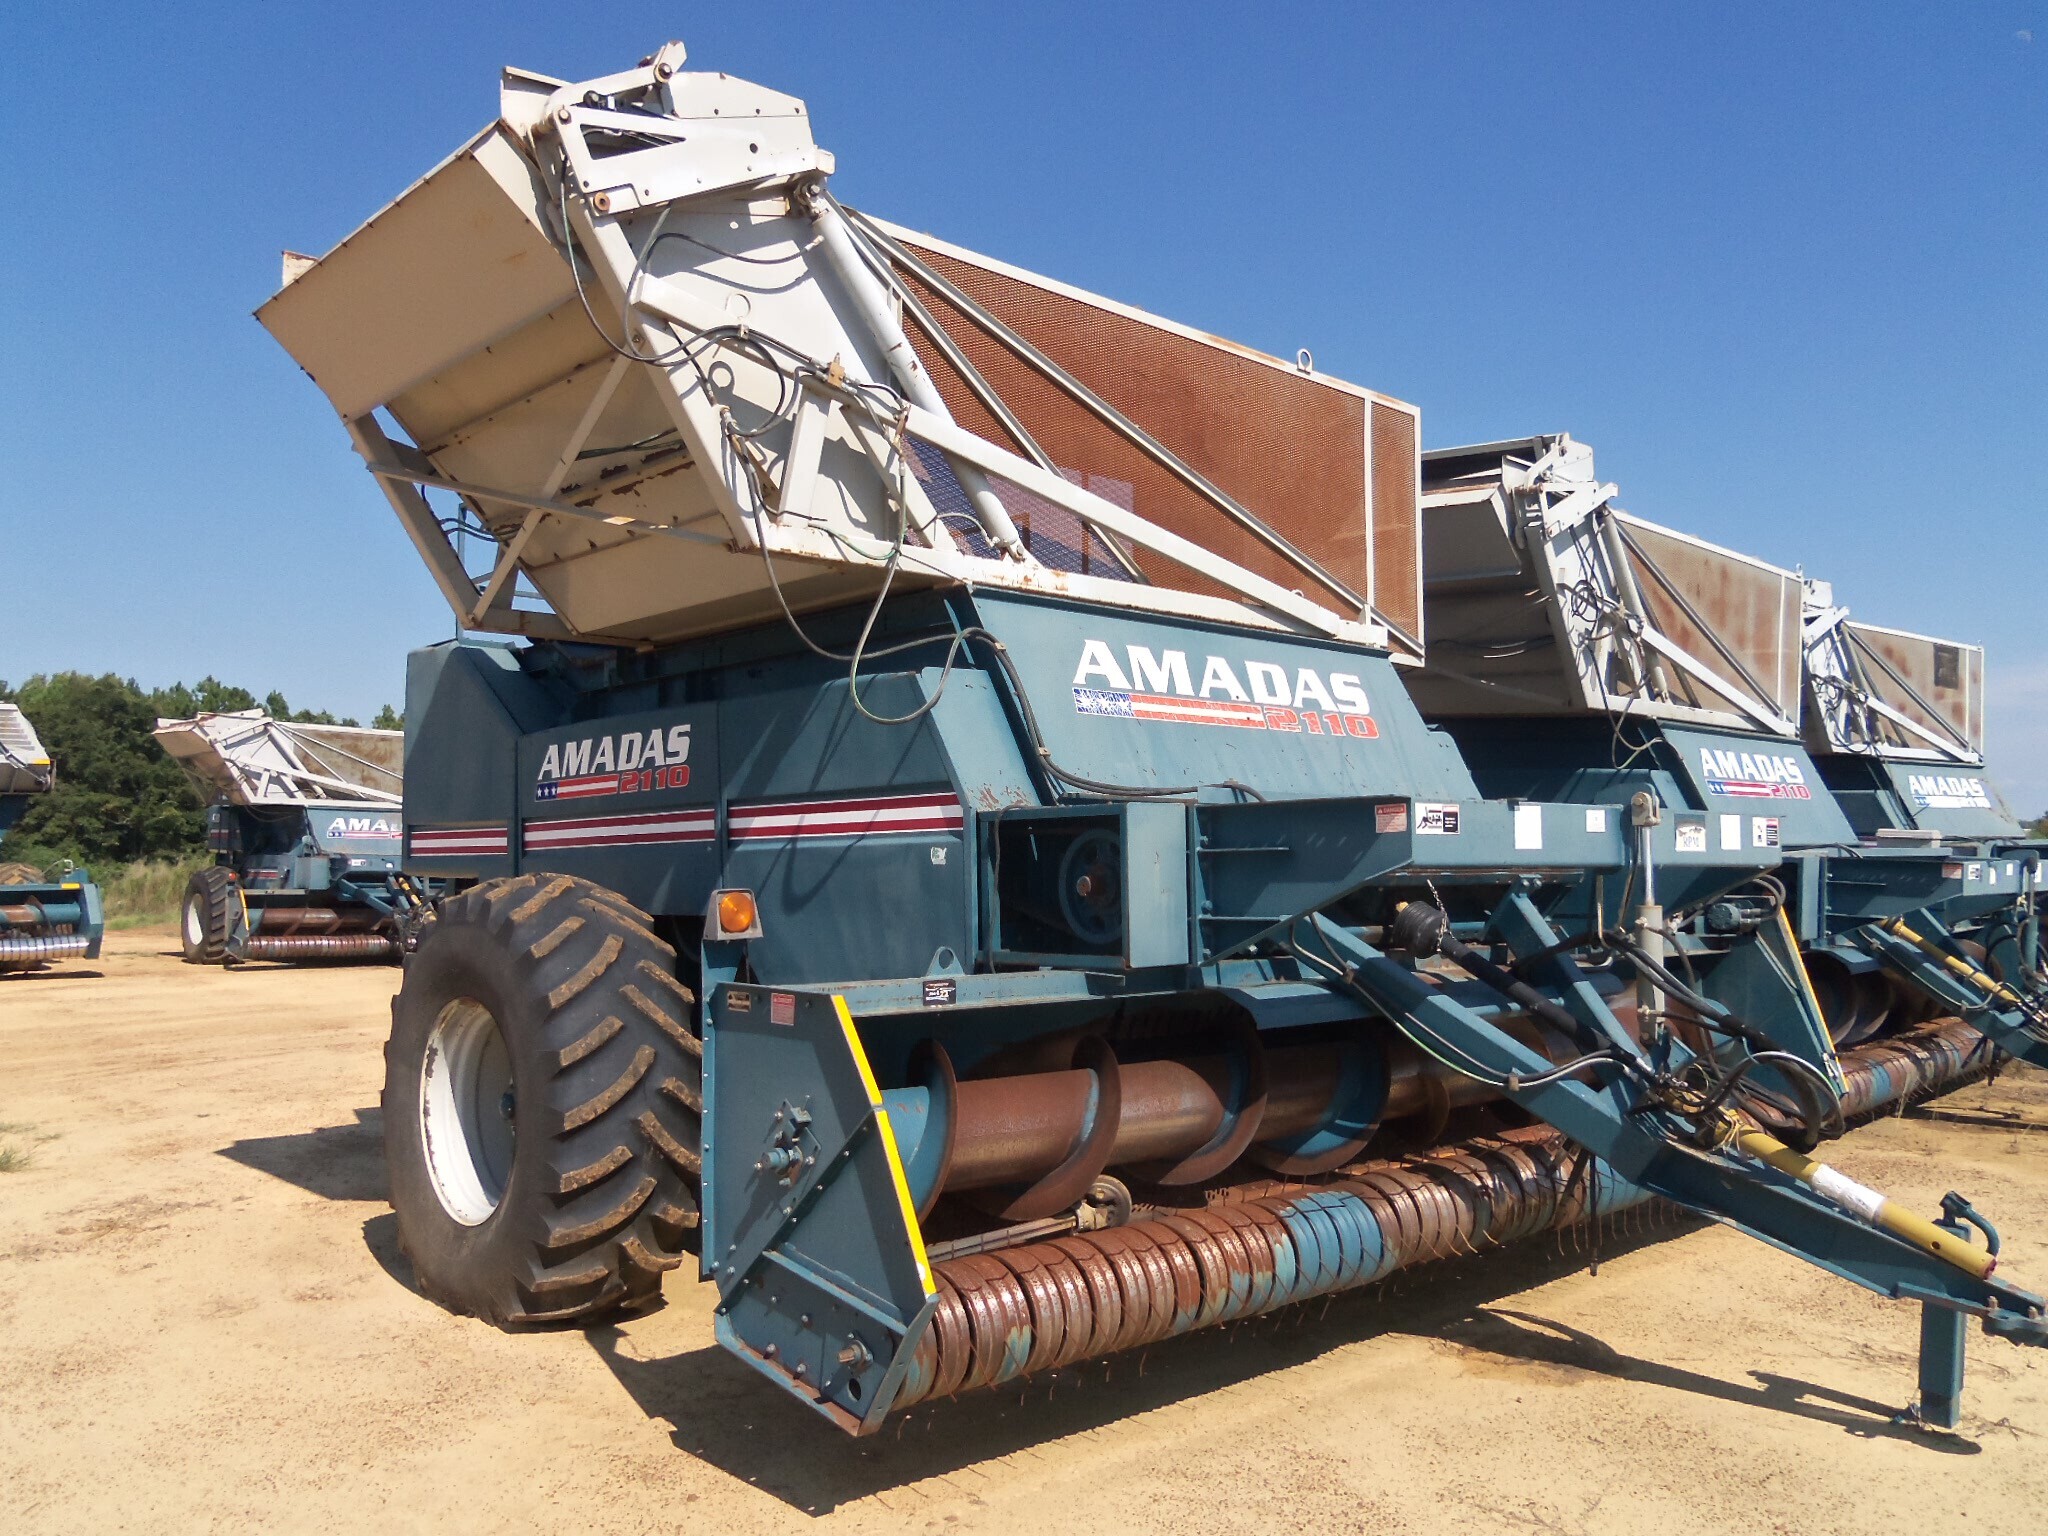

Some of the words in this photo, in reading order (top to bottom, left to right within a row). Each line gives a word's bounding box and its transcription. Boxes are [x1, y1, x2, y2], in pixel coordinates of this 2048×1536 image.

[1073, 639, 1370, 715] AMADAS
[1264, 706, 1379, 739] 2110
[537, 724, 691, 780] AMADAS
[1700, 748, 1804, 784] AMADAS
[619, 765, 690, 794] 2110
[1768, 783, 1811, 800] 2110
[1908, 775, 1985, 797] AMADAS
